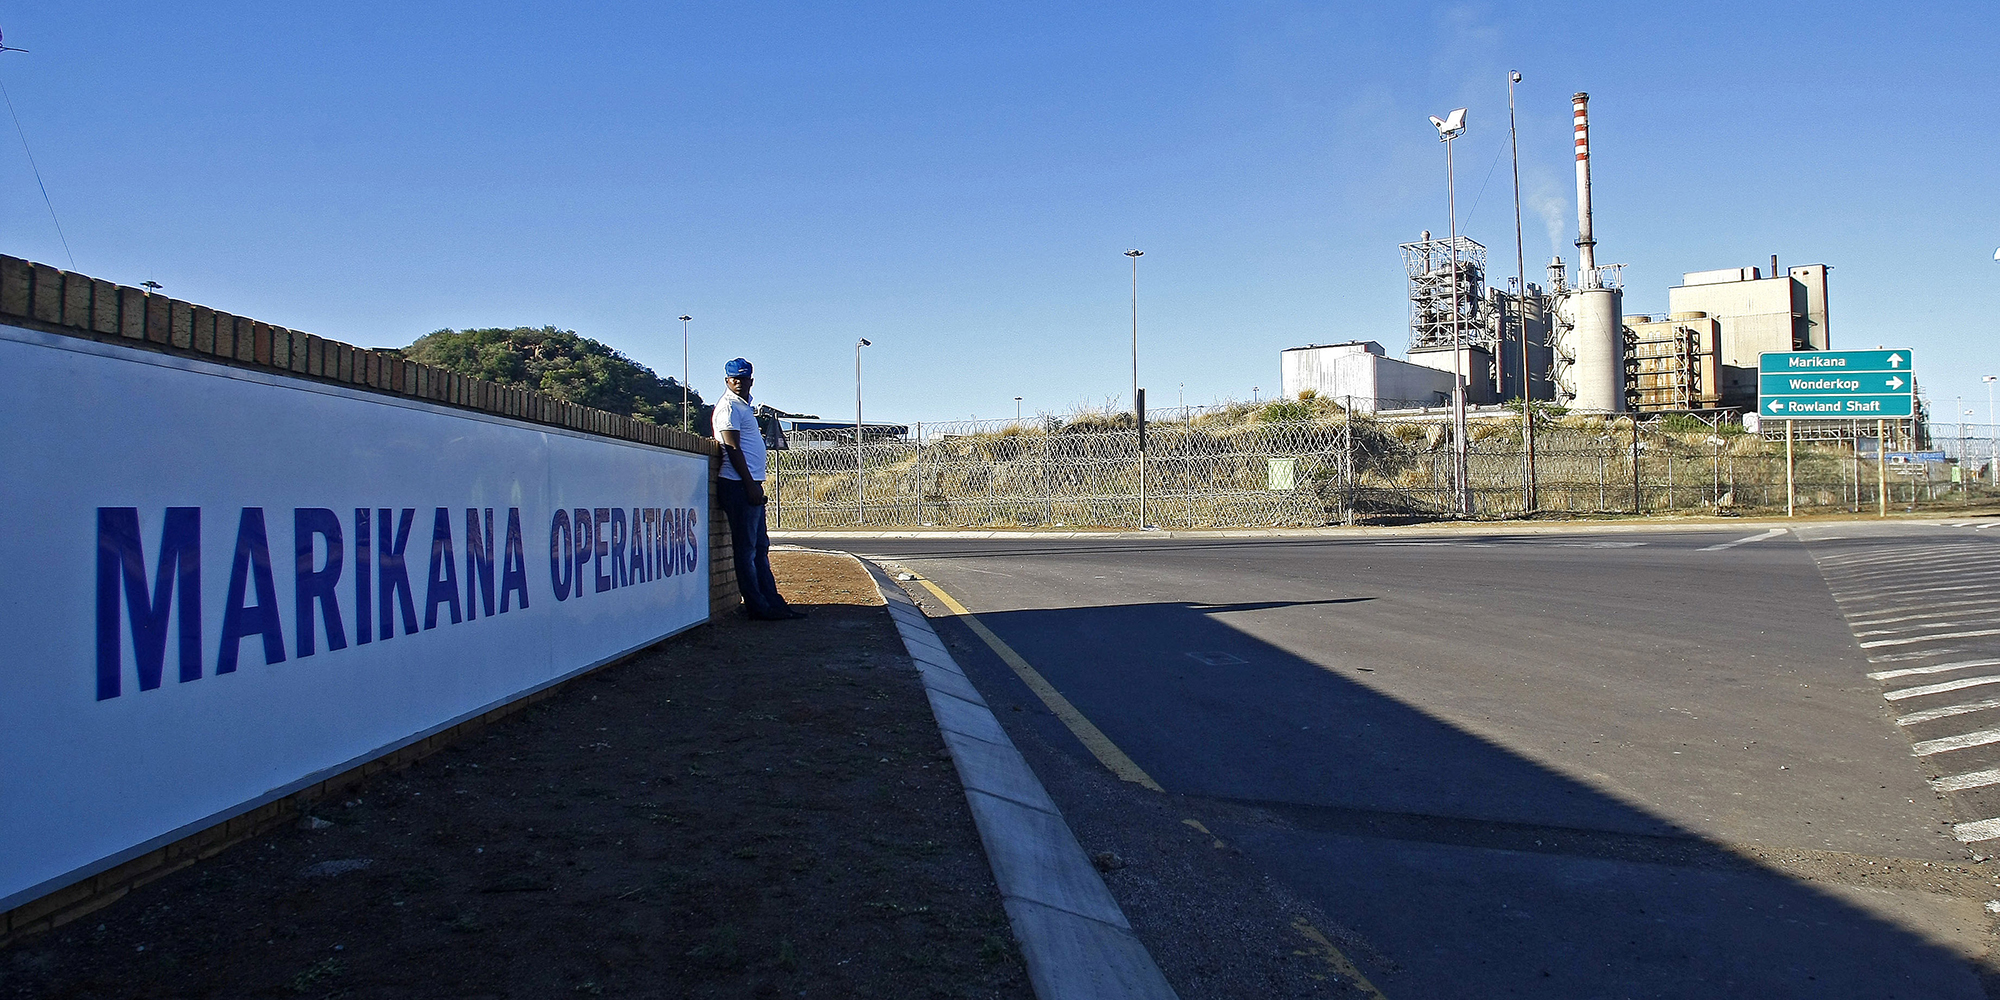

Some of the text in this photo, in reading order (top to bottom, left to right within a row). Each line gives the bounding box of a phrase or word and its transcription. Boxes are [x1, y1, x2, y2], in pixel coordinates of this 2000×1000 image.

[1788, 356, 1846, 368] Marikana
[1789, 379, 1859, 391] Wonderkop
[1788, 400, 1880, 412] Rowland Shaft
[97, 506, 698, 701] MARIKANA OPERATIONS
